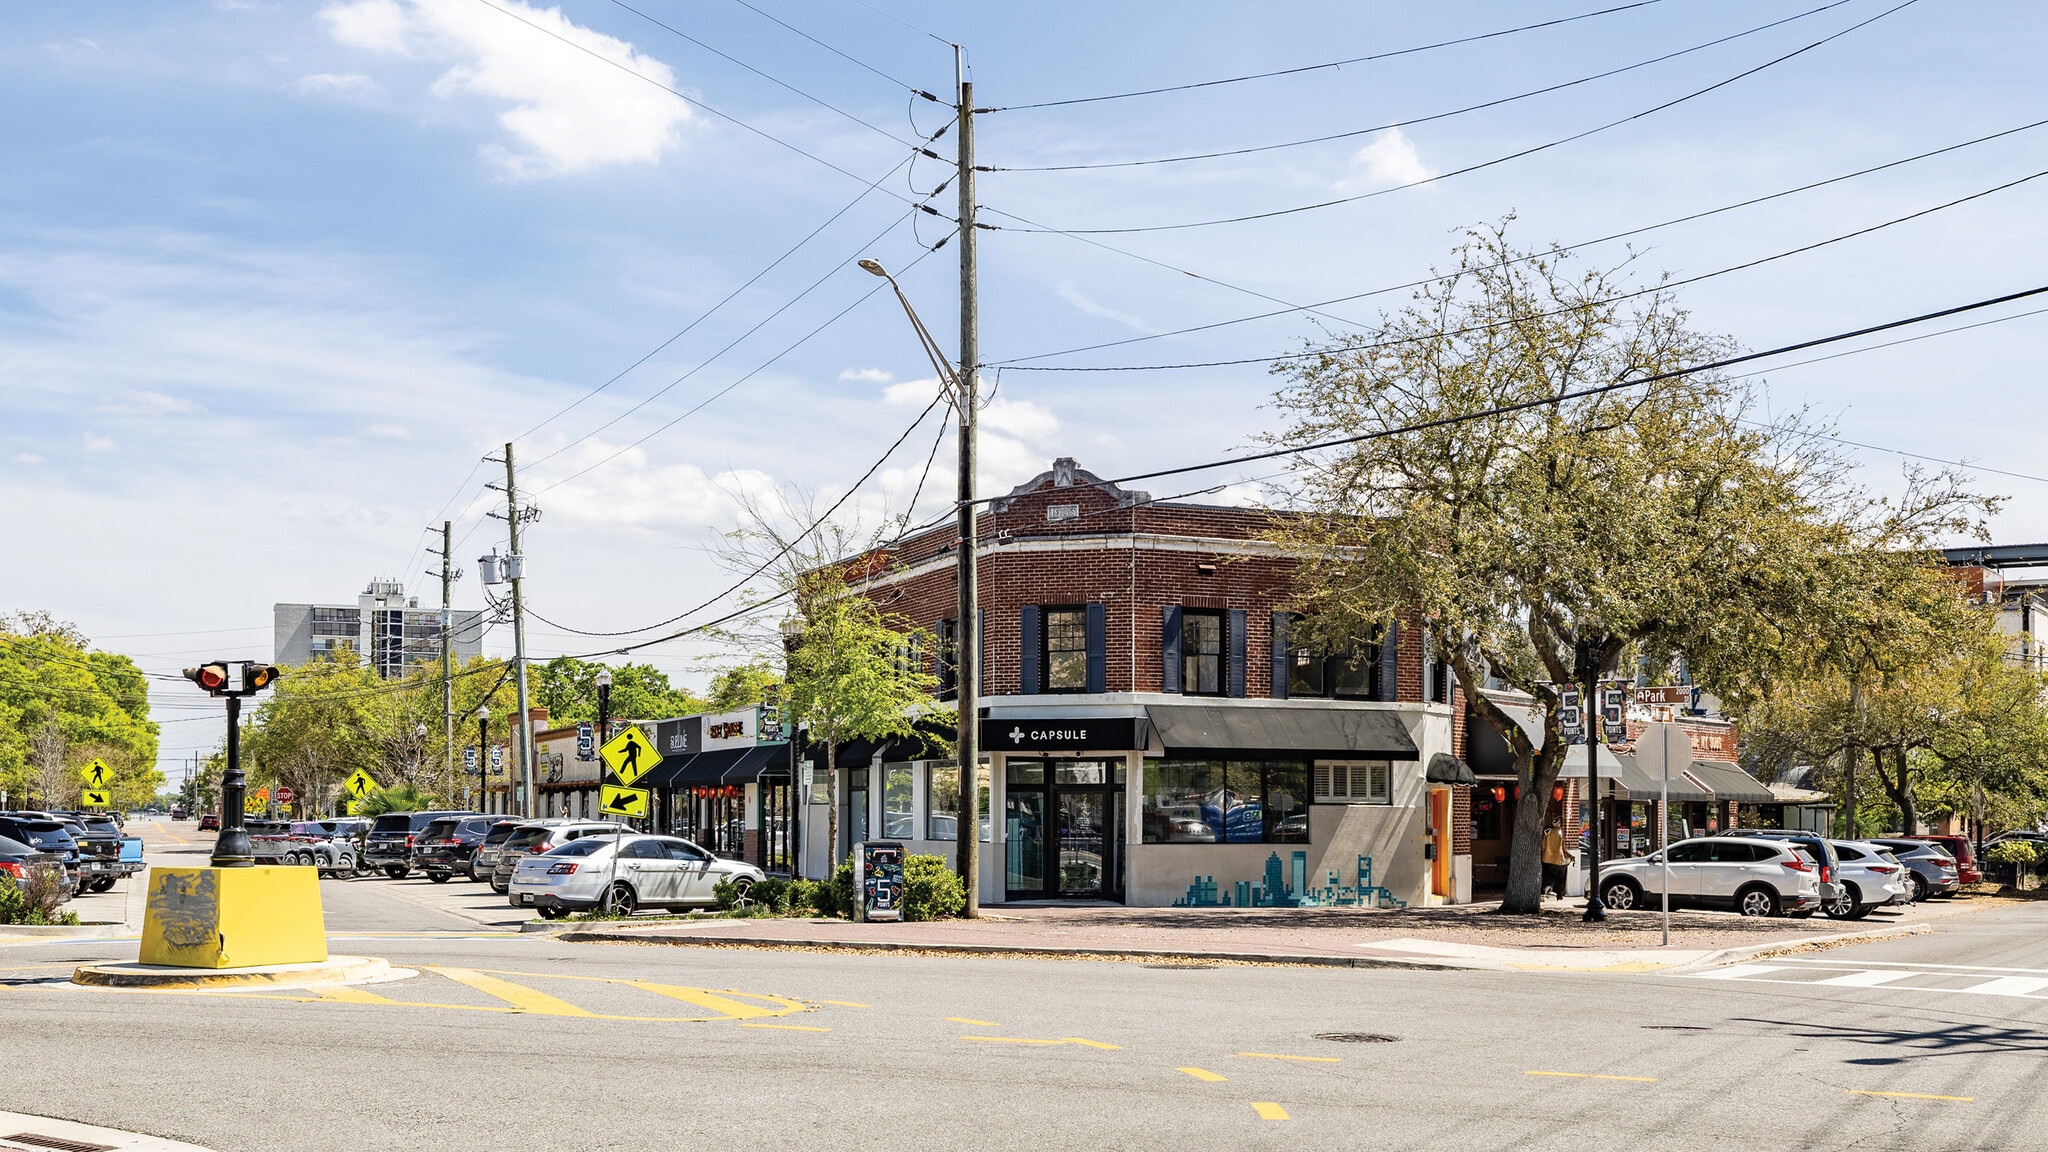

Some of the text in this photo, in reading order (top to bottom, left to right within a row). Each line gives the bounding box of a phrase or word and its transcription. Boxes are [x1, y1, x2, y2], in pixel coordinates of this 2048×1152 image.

[1645, 689, 1666, 703] Park
[1562, 691, 1580, 727] 5
[1605, 690, 1622, 725] 5
[580, 727, 592, 750] 5
[1030, 730, 1087, 740] CAPSULE
[1563, 727, 1581, 735] POINTS
[1605, 725, 1622, 734] POINTS
[877, 879, 891, 902] 5
